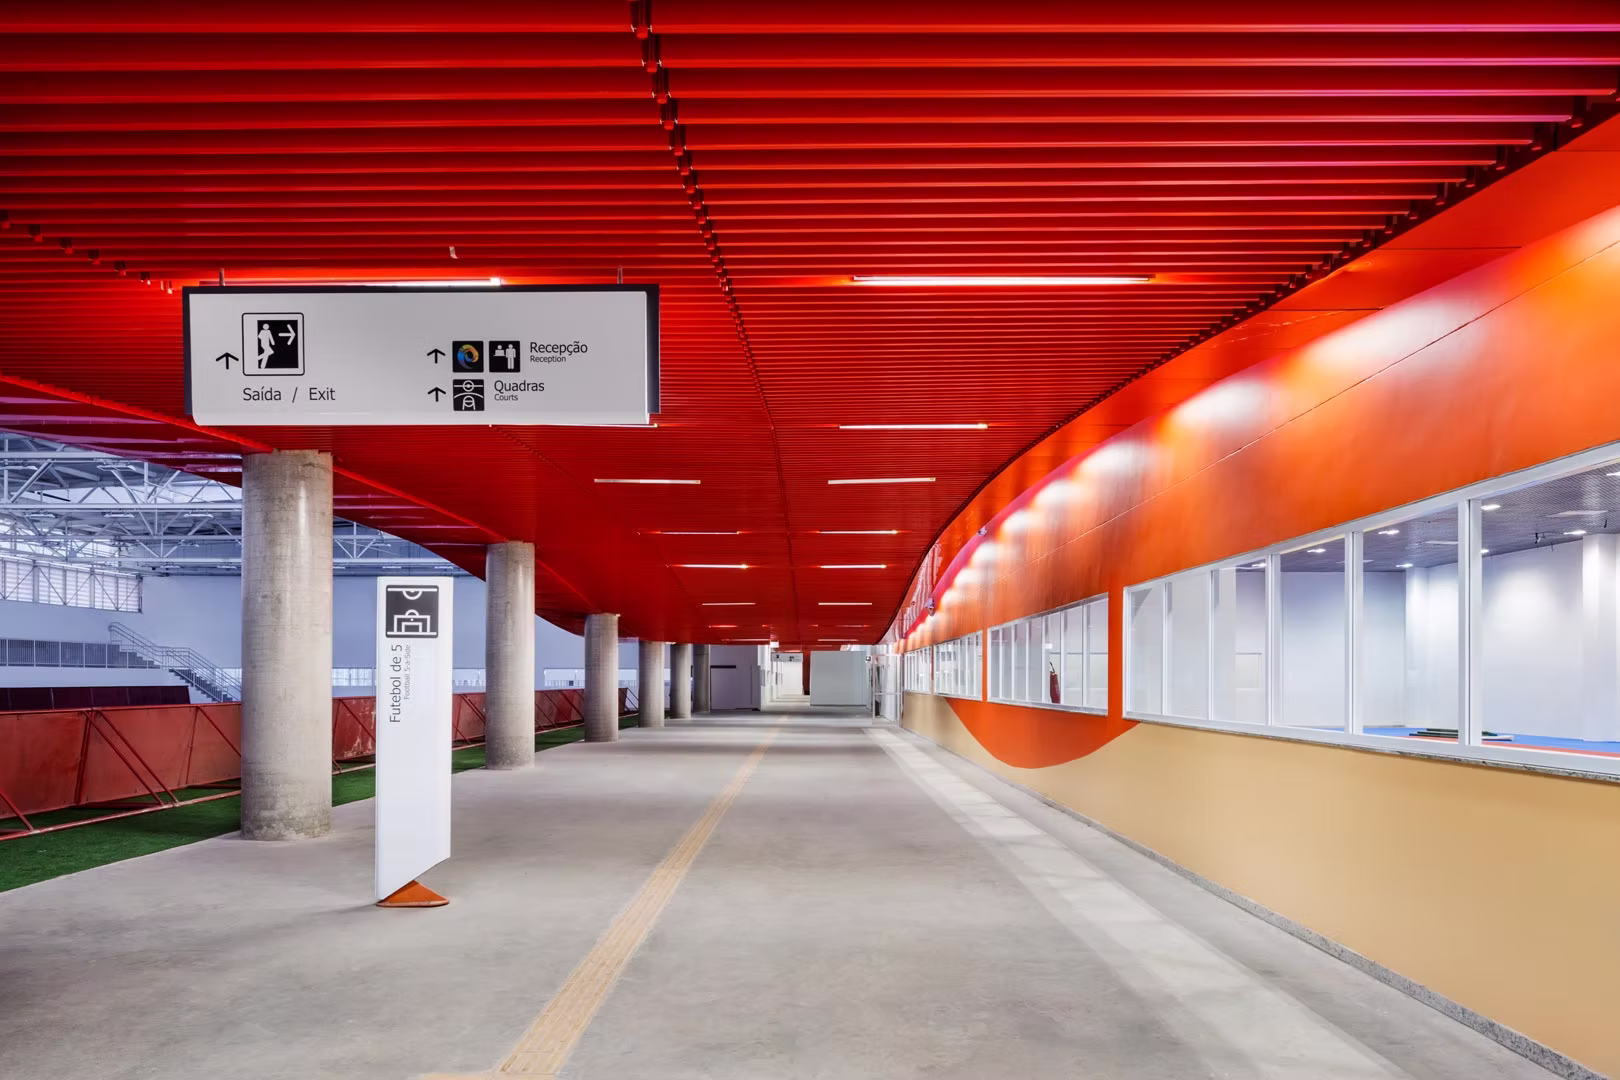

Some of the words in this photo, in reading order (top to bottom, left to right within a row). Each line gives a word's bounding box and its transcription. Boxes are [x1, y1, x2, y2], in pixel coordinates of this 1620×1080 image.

[529, 341, 588, 356] Recepção
[529, 355, 567, 364] Reception
[242, 386, 282, 401] Saída
[292, 387, 298, 403] /
[309, 387, 336, 401] Exit
[494, 380, 545, 394] Quadras
[391, 644, 403, 652] 5
[389, 656, 402, 672] de
[403, 673, 411, 700] Football
[389, 676, 402, 723] Futebol
